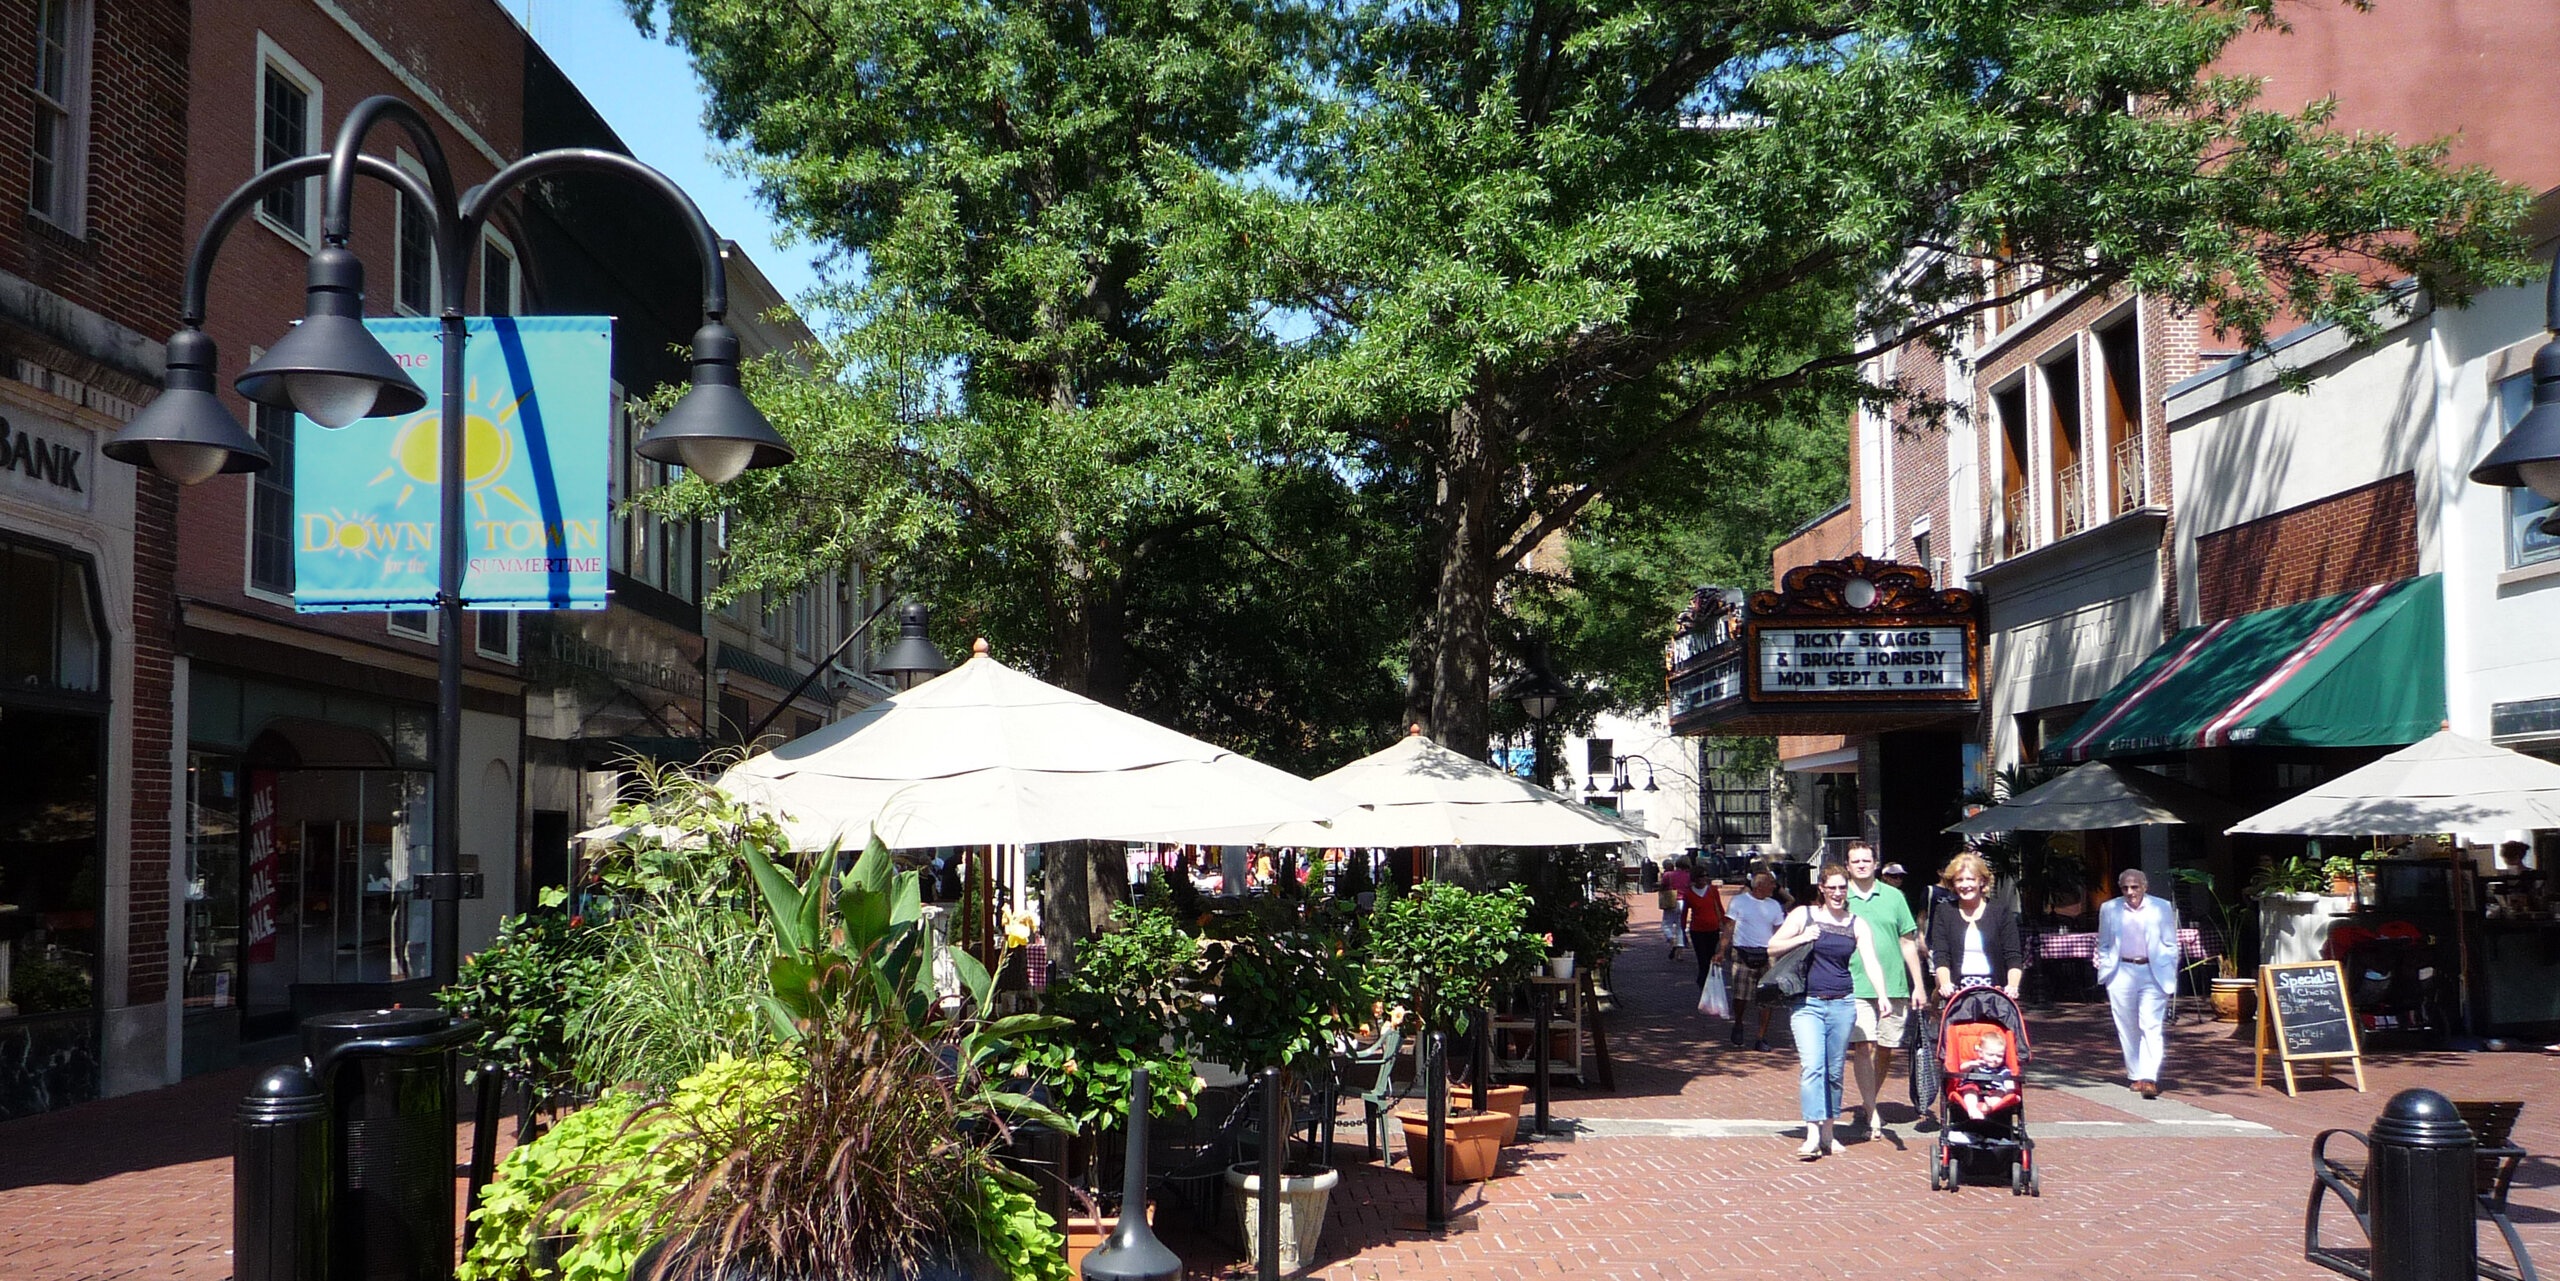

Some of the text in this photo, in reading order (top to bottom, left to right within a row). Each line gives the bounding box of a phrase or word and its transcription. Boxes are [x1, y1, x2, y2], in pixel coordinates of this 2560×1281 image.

[301, 513, 598, 551] DOWN TOWN
[469, 557, 601, 577] SUMMERTIME
[1794, 631, 1931, 648] RICKY SKAGGS
[1777, 650, 1946, 667] & BRUCE HORNSBY
[1778, 671, 1816, 686] MON
[1827, 671, 1871, 686] SEPT
[2279, 968, 2336, 993] Specials
